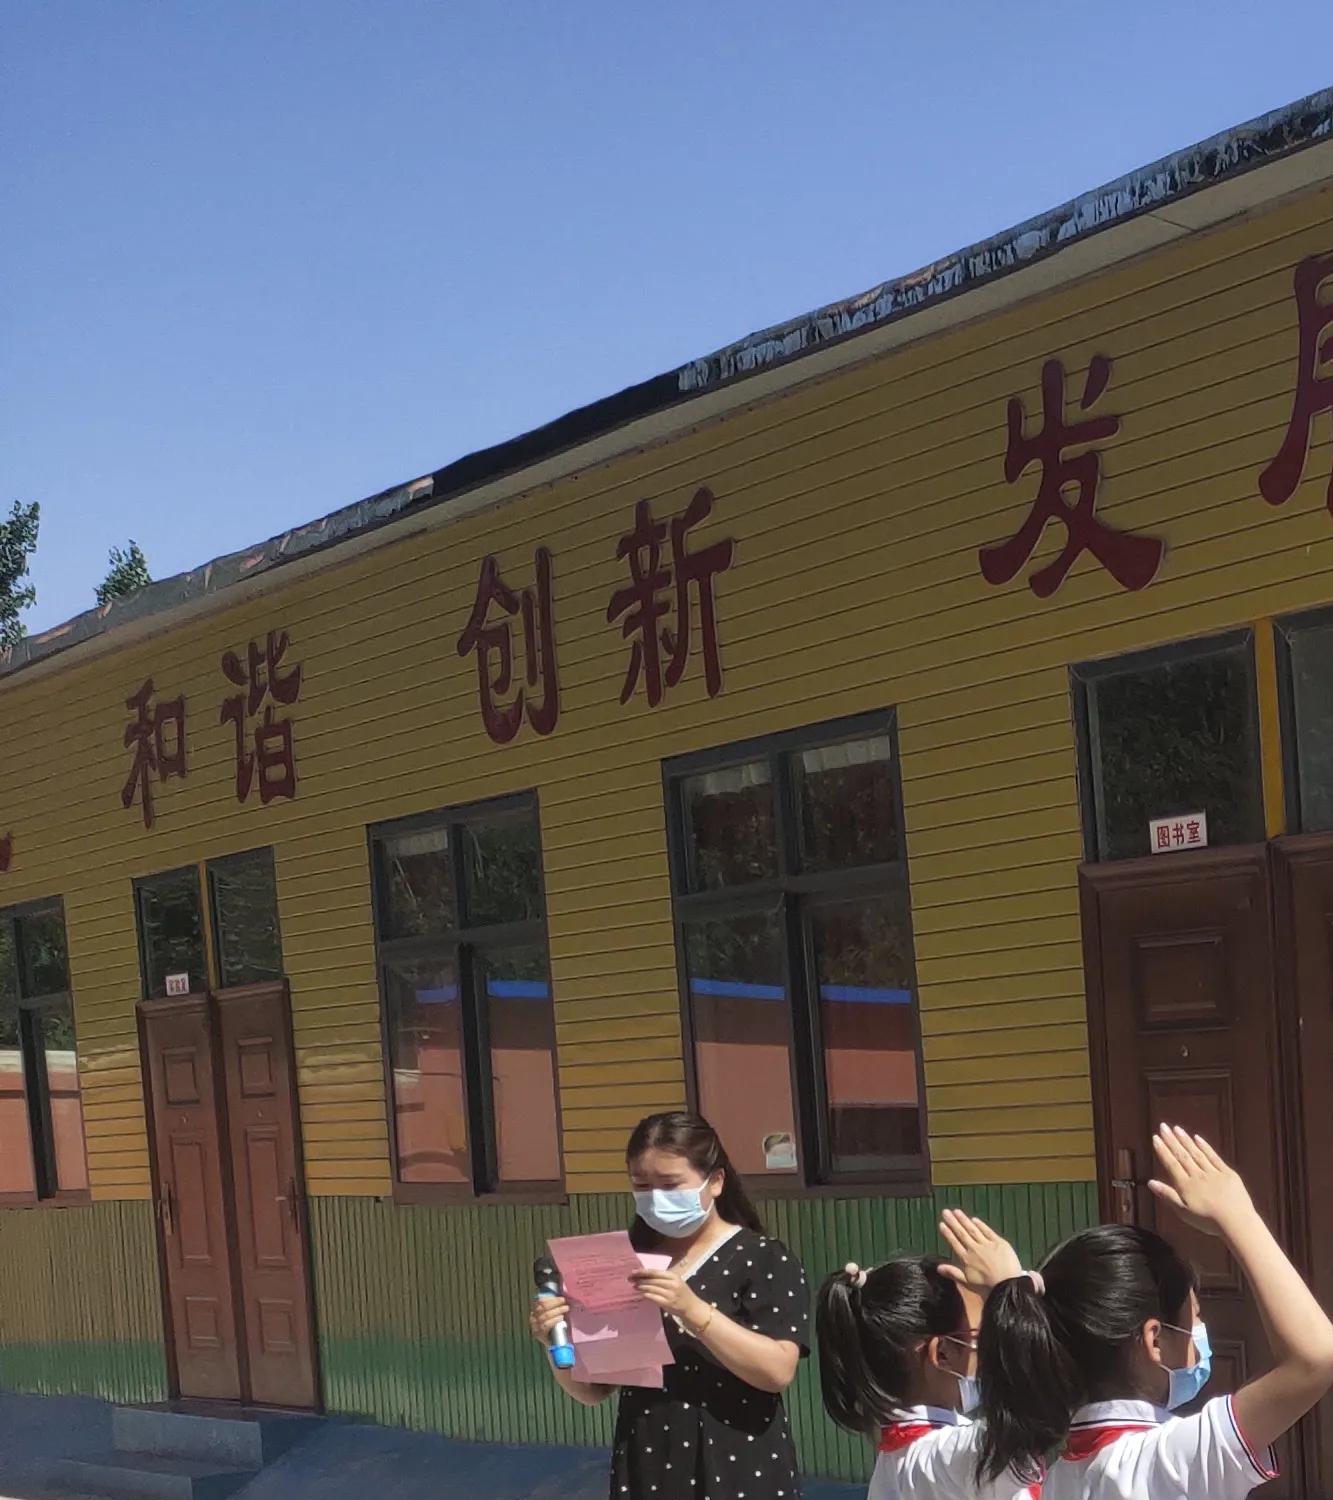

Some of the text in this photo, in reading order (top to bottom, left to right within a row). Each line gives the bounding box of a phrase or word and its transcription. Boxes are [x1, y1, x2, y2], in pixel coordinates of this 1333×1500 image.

[121, 630, 302, 829] 和谐
[457, 487, 737, 745] 创新
[1156, 820, 1201, 849] 图书室
